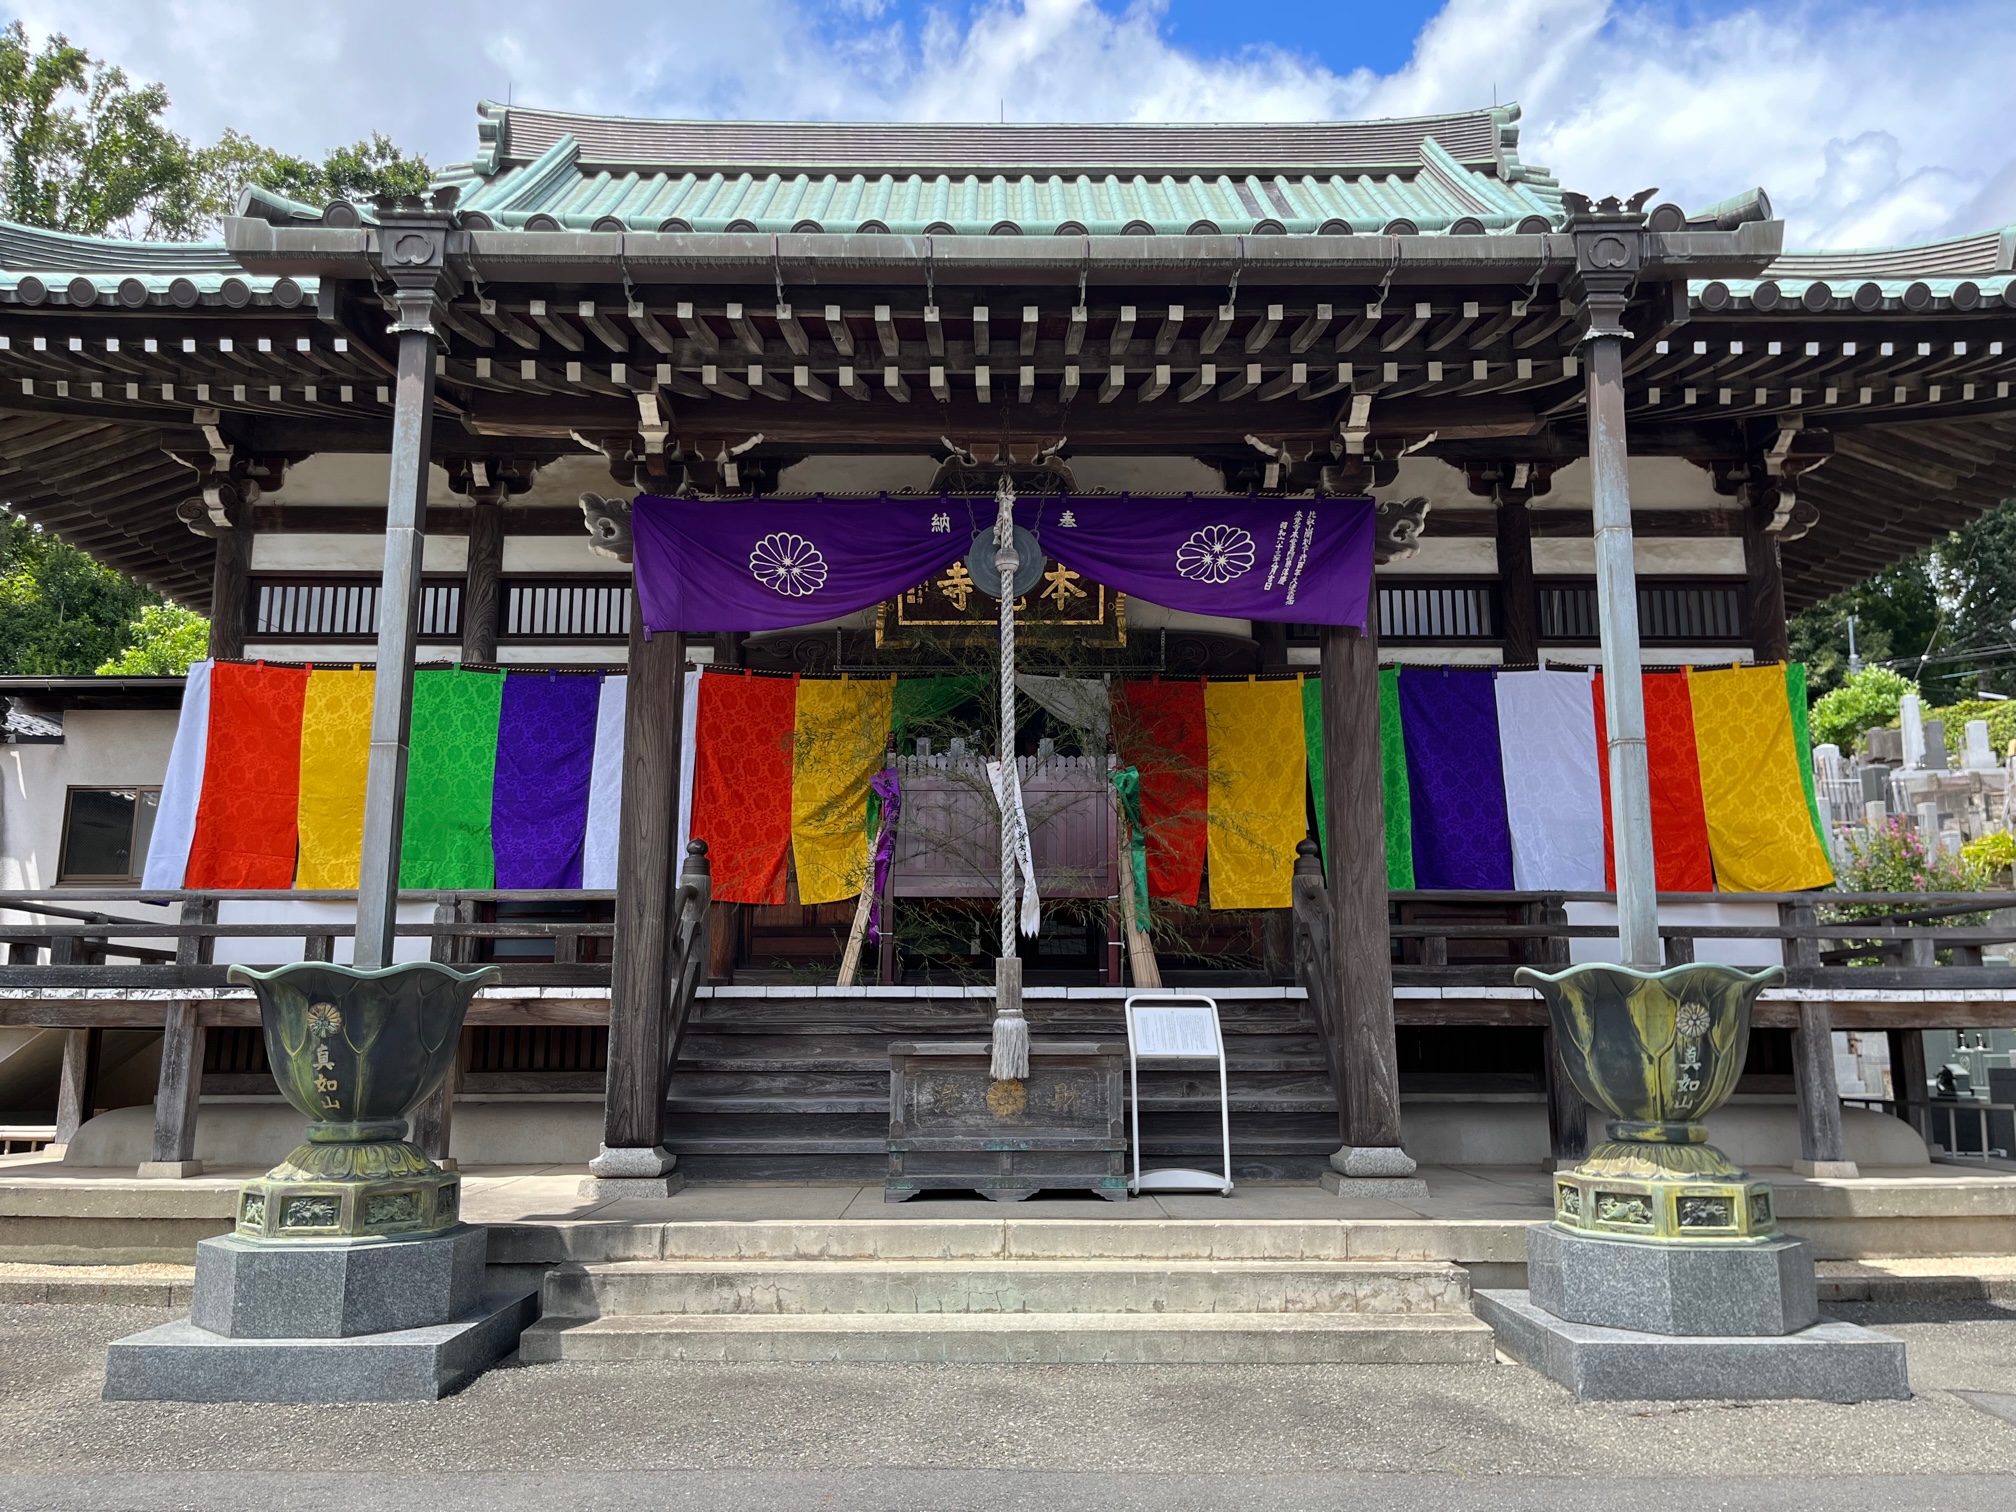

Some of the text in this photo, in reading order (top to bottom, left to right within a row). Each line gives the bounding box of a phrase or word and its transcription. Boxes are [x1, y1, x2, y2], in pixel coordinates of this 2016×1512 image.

[931, 510, 1078, 533] 奉 納
[936, 561, 1088, 612] 本寺
